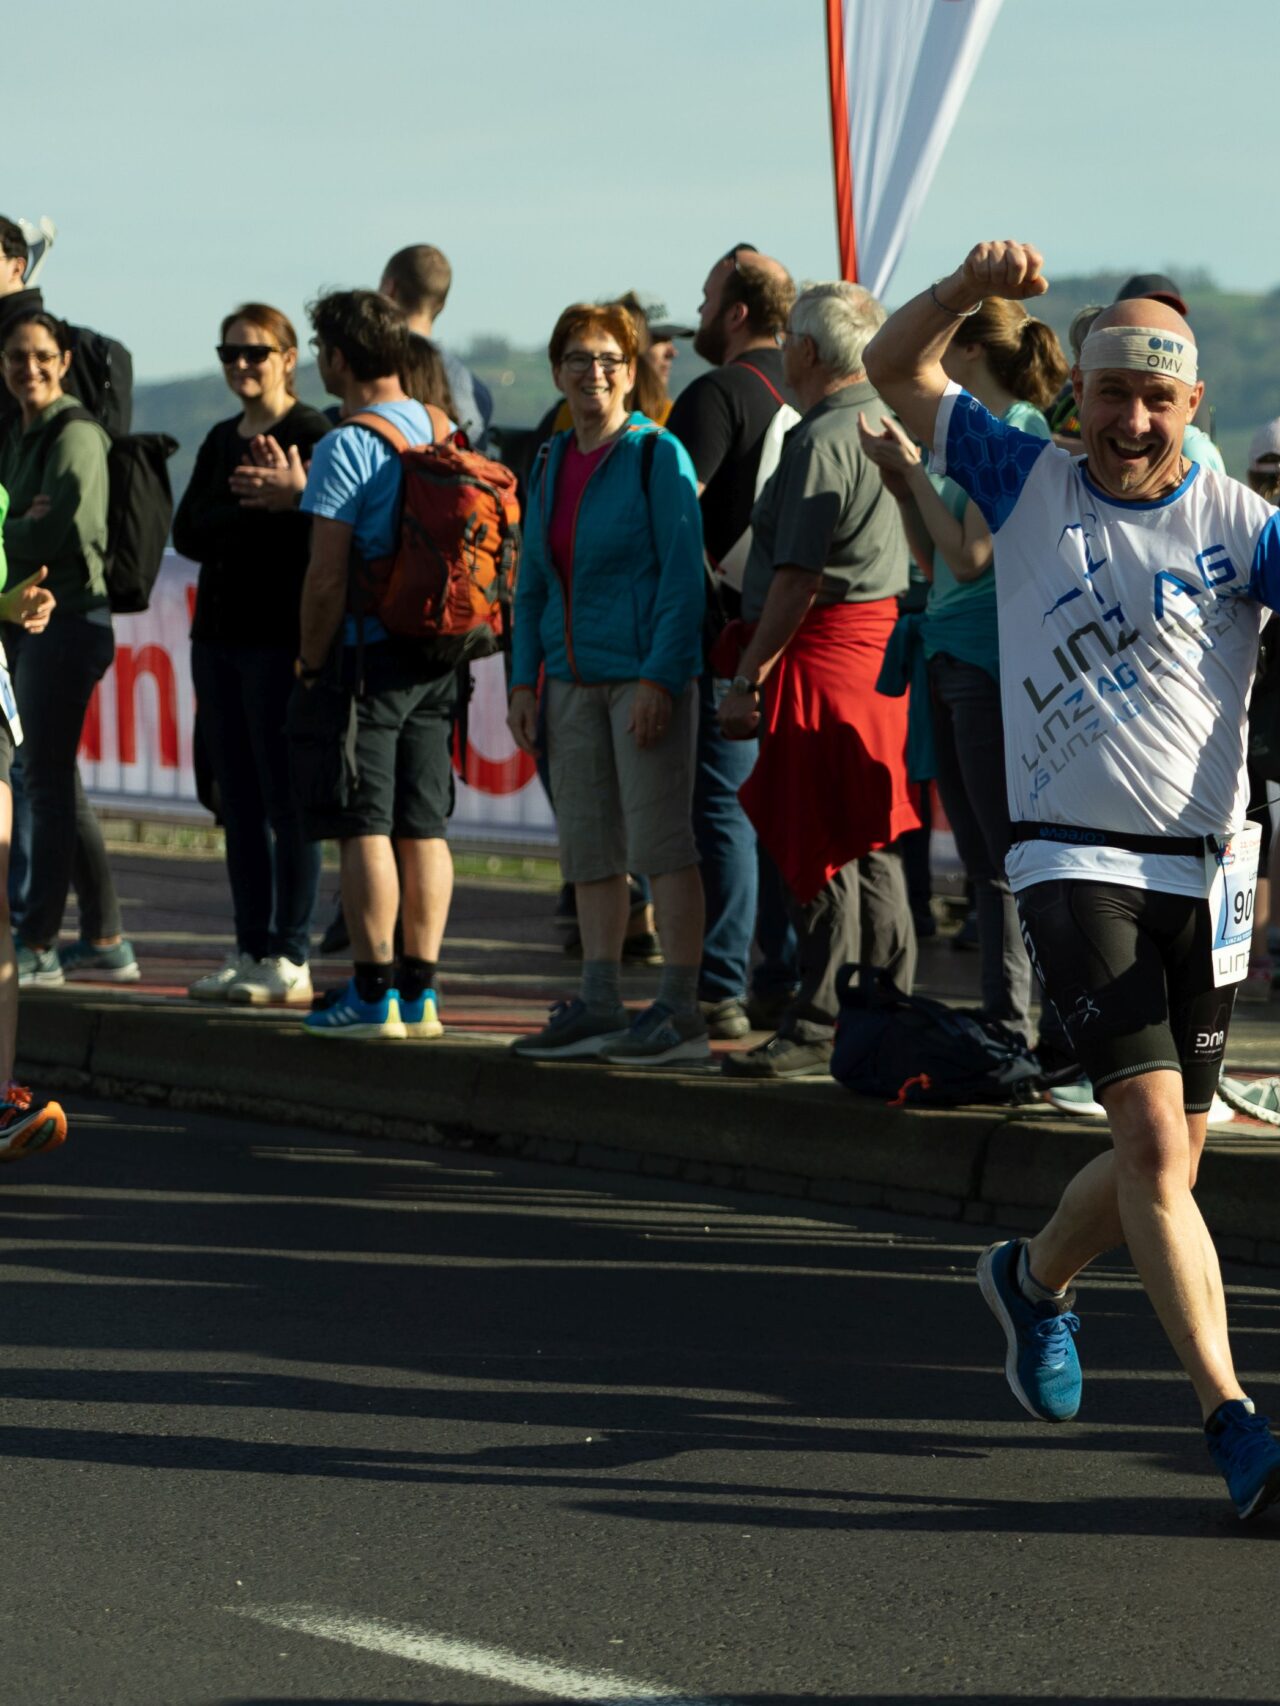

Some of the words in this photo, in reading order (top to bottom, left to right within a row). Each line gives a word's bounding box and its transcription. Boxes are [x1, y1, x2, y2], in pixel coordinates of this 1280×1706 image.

[1147, 354, 1182, 373] OMV
[1153, 544, 1237, 621] AG
[1097, 662, 1139, 698] AG
[1195, 1030, 1224, 1047] DNA
